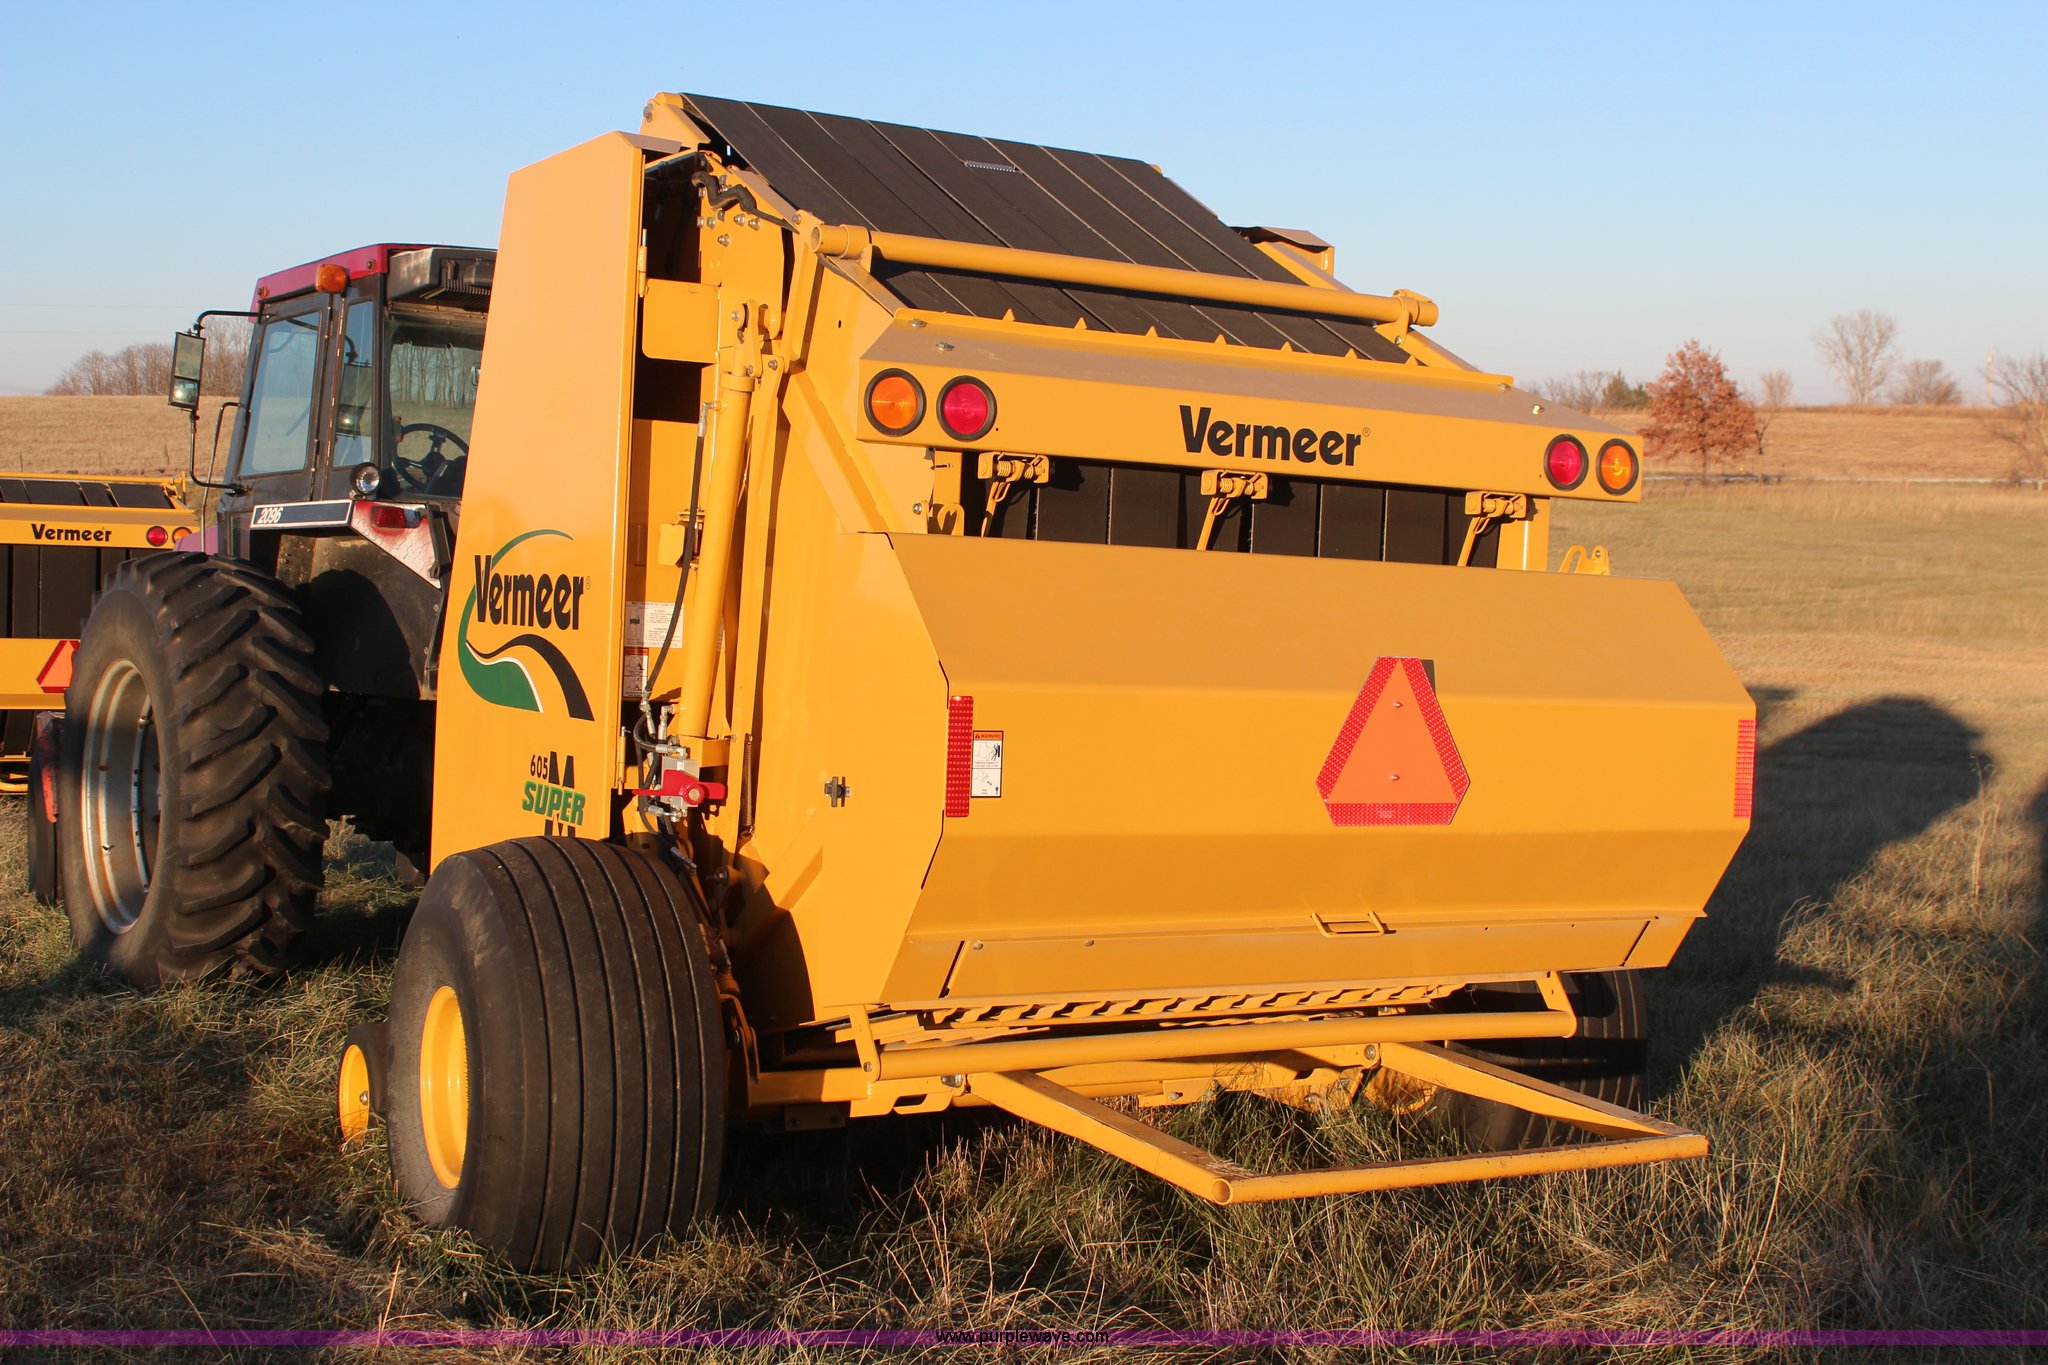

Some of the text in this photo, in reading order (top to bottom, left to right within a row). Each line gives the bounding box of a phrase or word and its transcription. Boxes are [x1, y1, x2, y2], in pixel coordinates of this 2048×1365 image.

[1179, 405, 1361, 466] Vermeer
[31, 523, 112, 542] Vermeer
[257, 506, 284, 524] 2096
[474, 554, 584, 630] Vermeer
[530, 753, 549, 780] 605
[522, 780, 586, 826] SUPER
